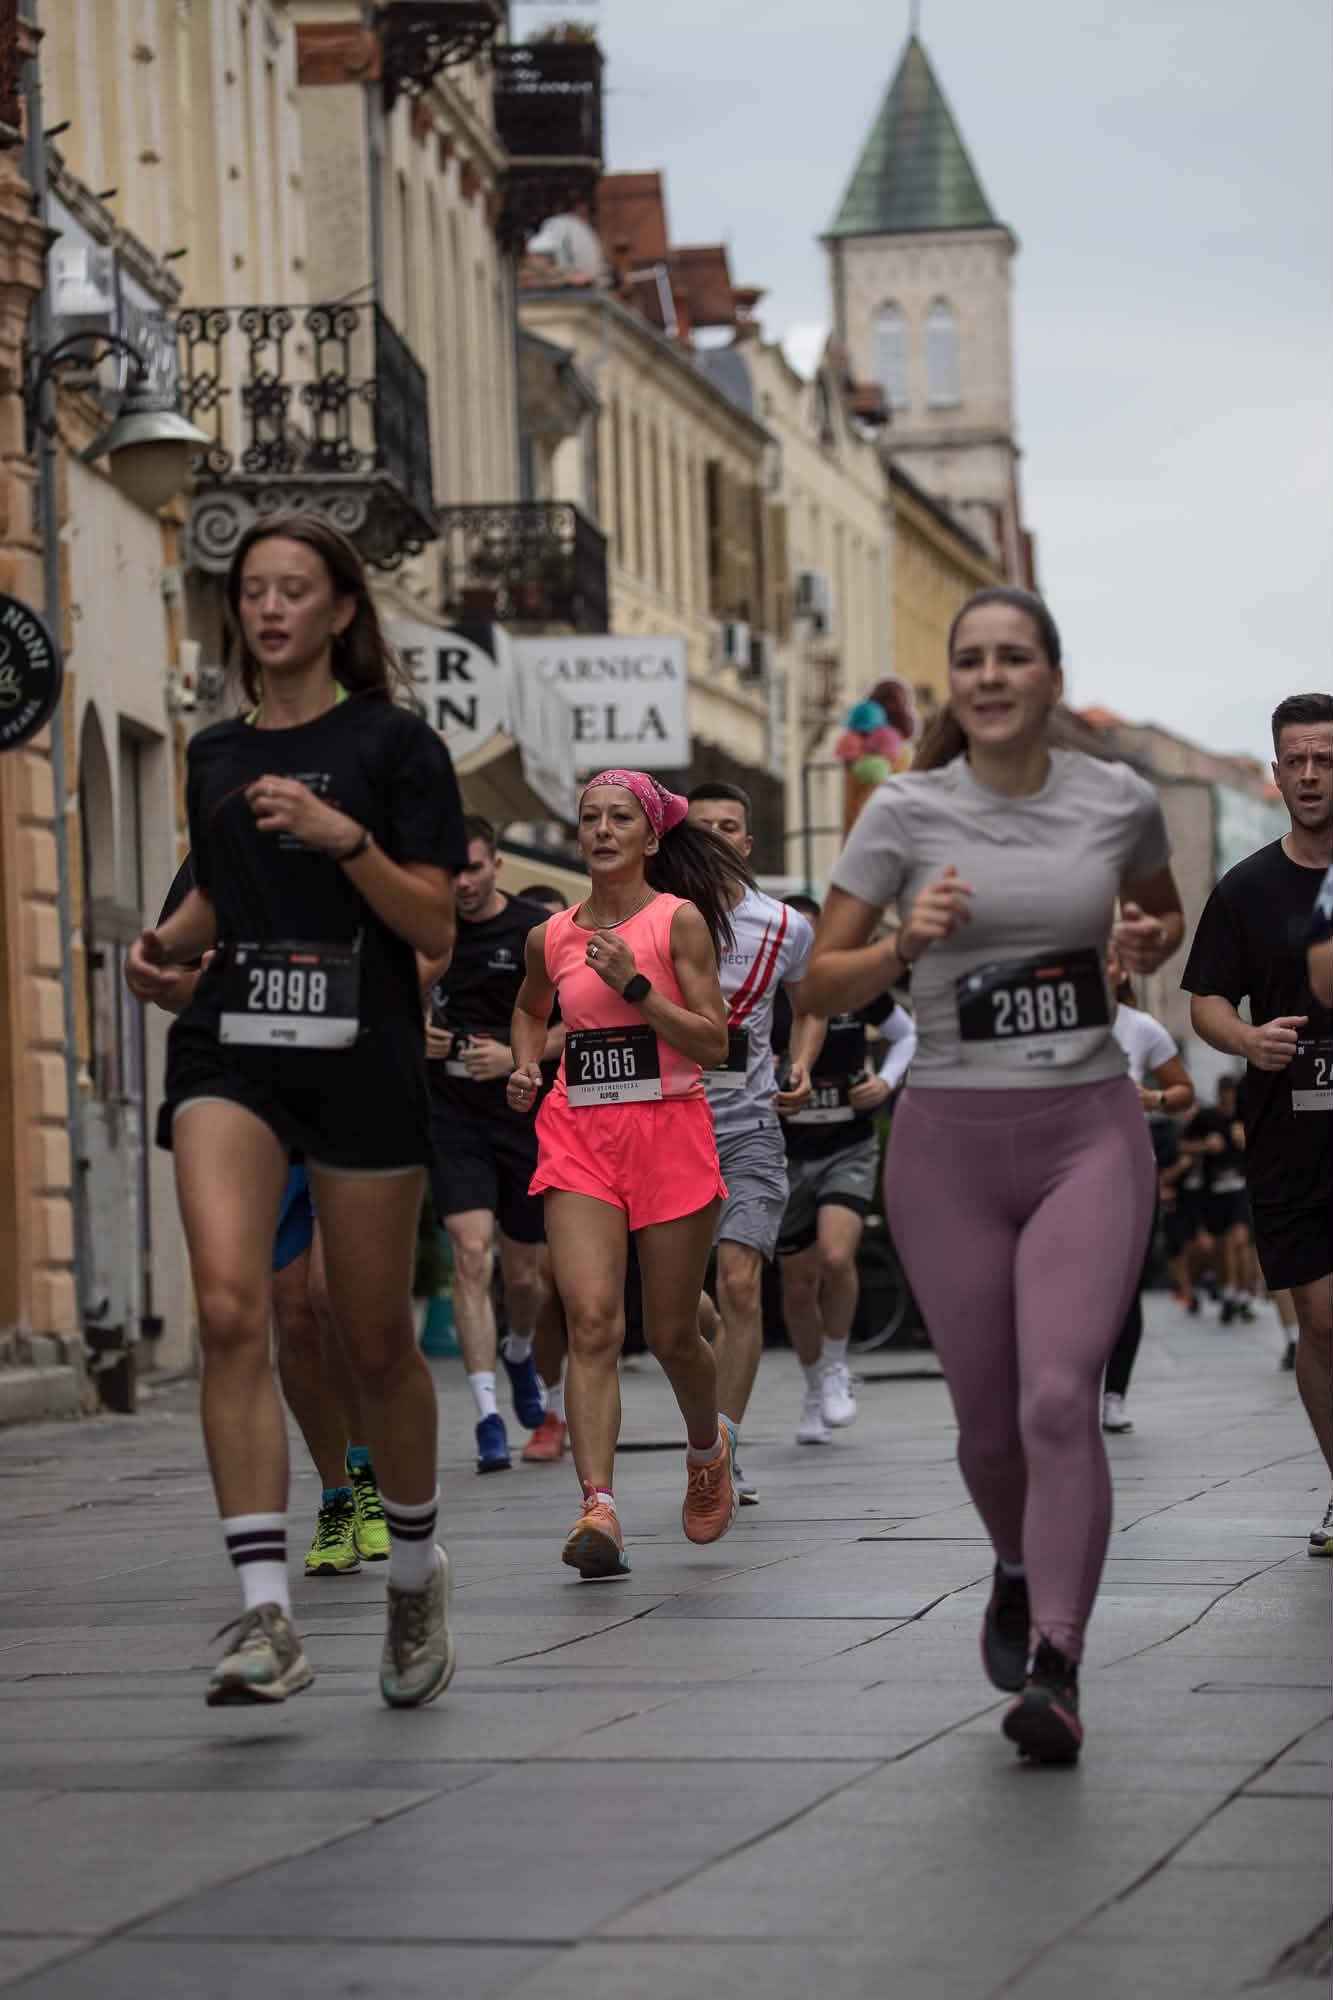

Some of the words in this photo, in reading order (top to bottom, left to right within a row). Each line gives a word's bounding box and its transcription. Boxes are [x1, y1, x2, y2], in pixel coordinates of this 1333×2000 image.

[2, 604, 50, 670] NONI
[247, 968, 328, 1013] 2898
[991, 980, 1079, 1036] 2383
[580, 1047, 637, 1081] 2865
